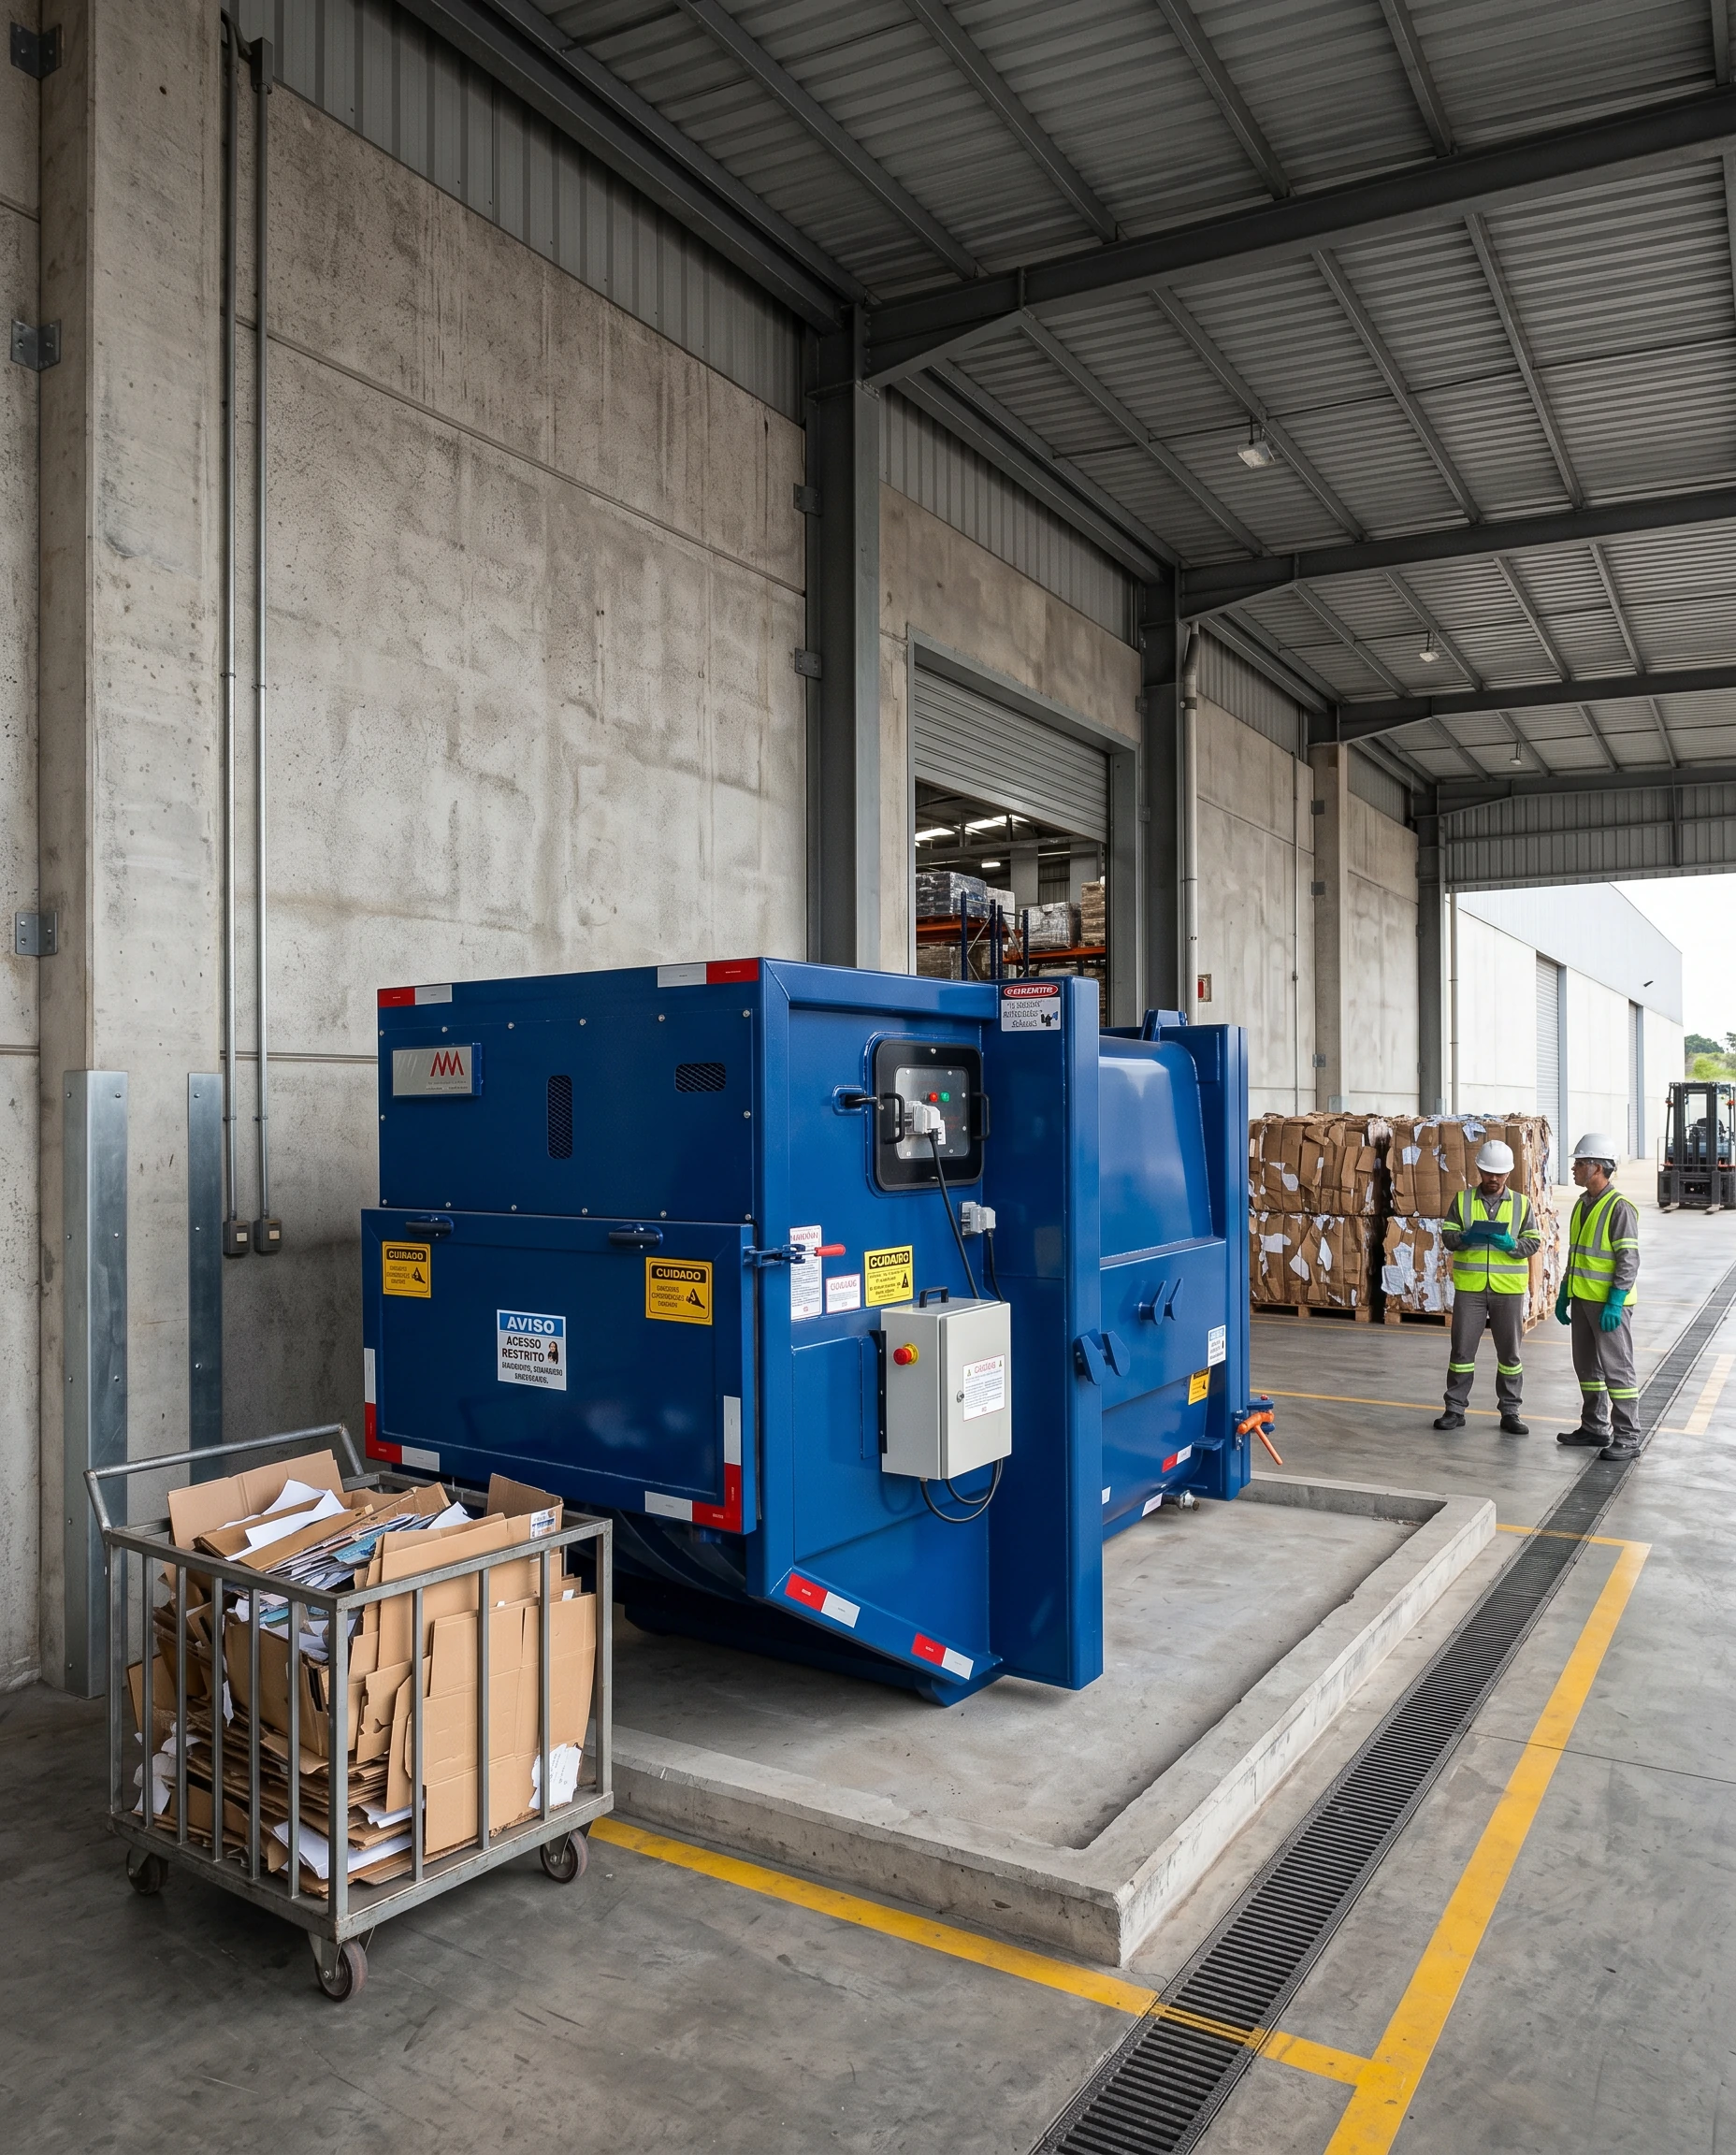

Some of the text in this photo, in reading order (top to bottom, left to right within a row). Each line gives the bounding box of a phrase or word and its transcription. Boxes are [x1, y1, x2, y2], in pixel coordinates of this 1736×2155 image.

[656, 1268, 702, 1280] CUIDADO
[507, 1316, 555, 1334] AVISO
[506, 1336, 542, 1349] ACESSO
[501, 1348, 545, 1363] RESTRITO
